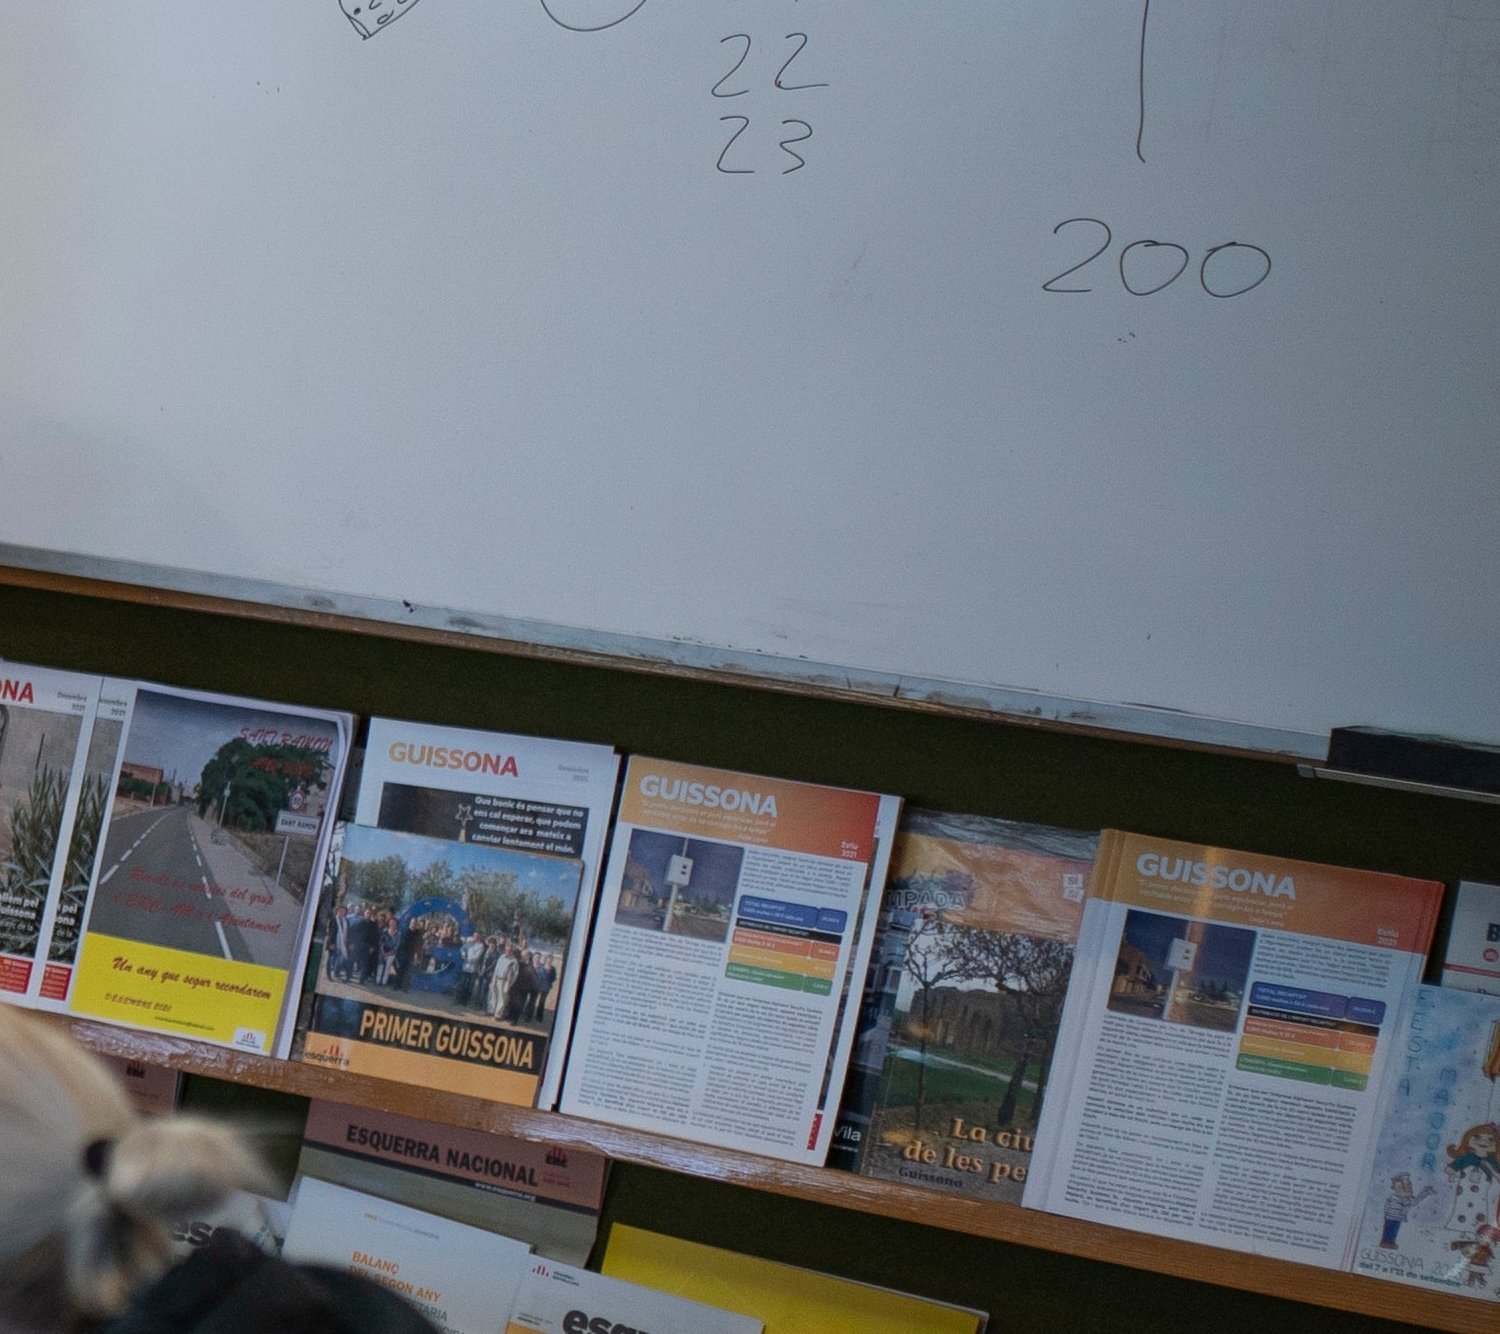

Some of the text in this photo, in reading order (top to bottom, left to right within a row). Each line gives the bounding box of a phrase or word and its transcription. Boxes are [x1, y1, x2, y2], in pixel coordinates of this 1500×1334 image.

[711, 32, 828, 98] 22
[716, 117, 814, 174] 23
[1043, 217, 1271, 297] 200
[388, 742, 519, 777] GUISSONA
[640, 775, 778, 818] GUISSONA
[1136, 852, 1296, 900] GUISSONA
[113, 957, 271, 1000] Un any que segur recordarem
[359, 1009, 534, 1069] PRIMER GUISSONA
[952, 1117, 987, 1142] La
[346, 1124, 440, 1163] ESQUERRA
[446, 1149, 538, 1187] NACIONAL
[903, 1140, 1026, 1184] de les pe
[352, 1251, 399, 1274] BALANÇ
[374, 1273, 413, 1293] SEGON
[416, 1285, 441, 1302] ANY
